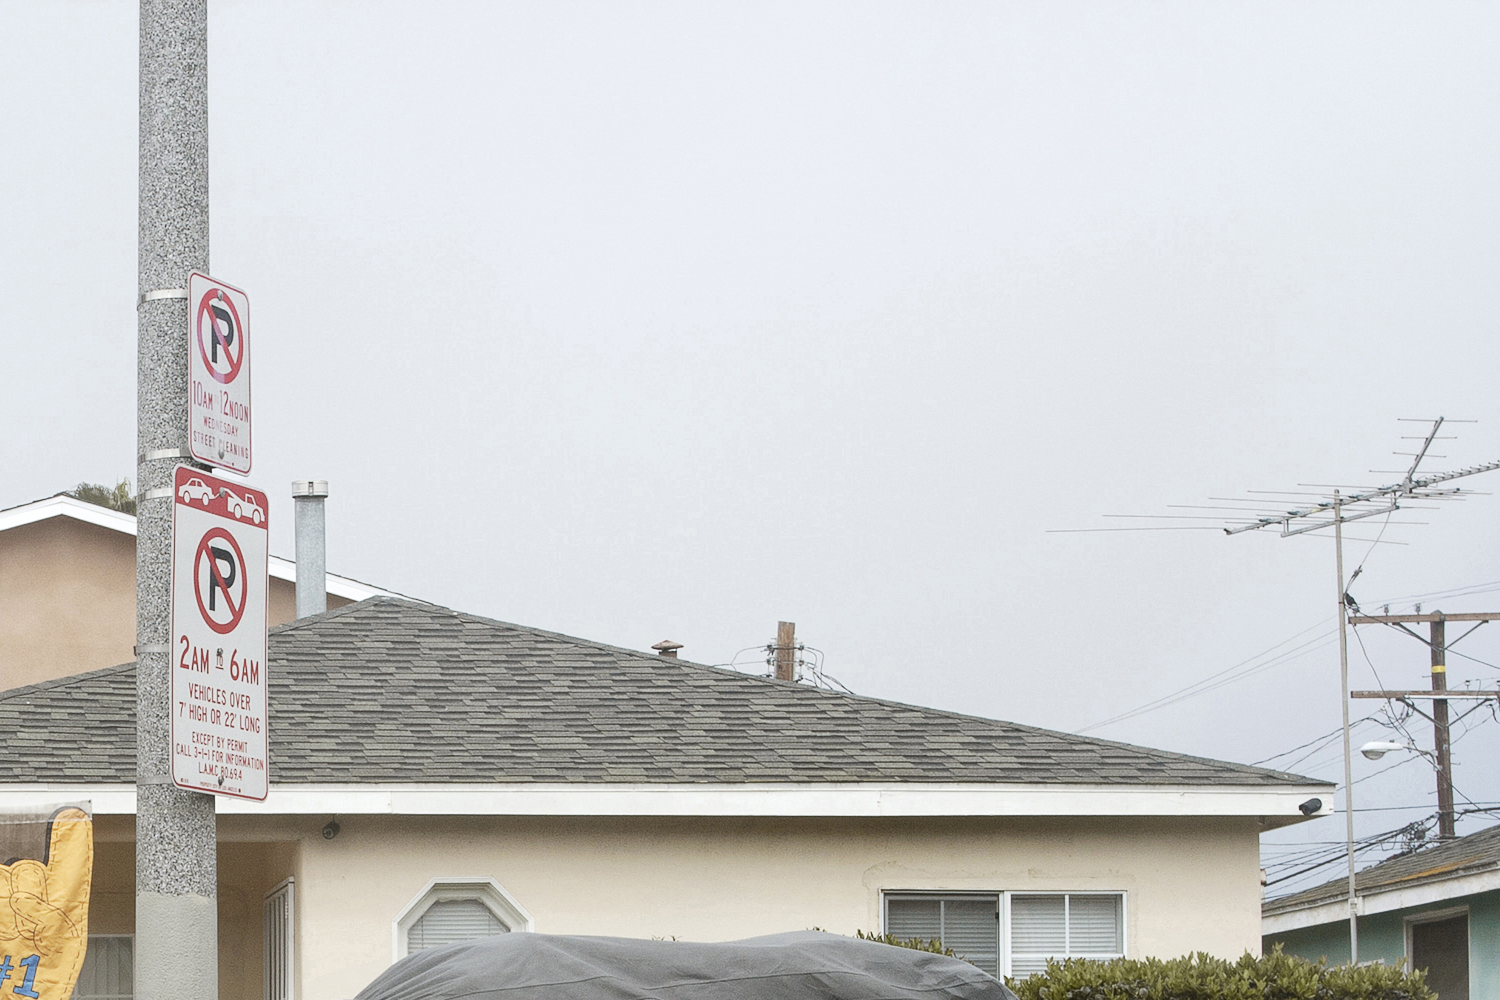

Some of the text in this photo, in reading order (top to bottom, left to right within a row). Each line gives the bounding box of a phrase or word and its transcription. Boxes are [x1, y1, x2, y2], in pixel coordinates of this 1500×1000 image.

[193, 380, 213, 411] 10AM
[220, 390, 249, 423] 12NOON
[203, 416, 238, 437] WEDNESDAY
[193, 430, 249, 460] STREET CLEANING
[180, 635, 210, 675] 2AM
[230, 648, 260, 686] 6AM
[188, 682, 251, 711] VEHICLES OVER
[179, 701, 261, 734] 7' HIGH OR 22' LONG
[176, 742, 265, 771] CALL 3-1-1 FOR INFORMATION
[192, 731, 248, 753] EXCEPT BY PERMIT
